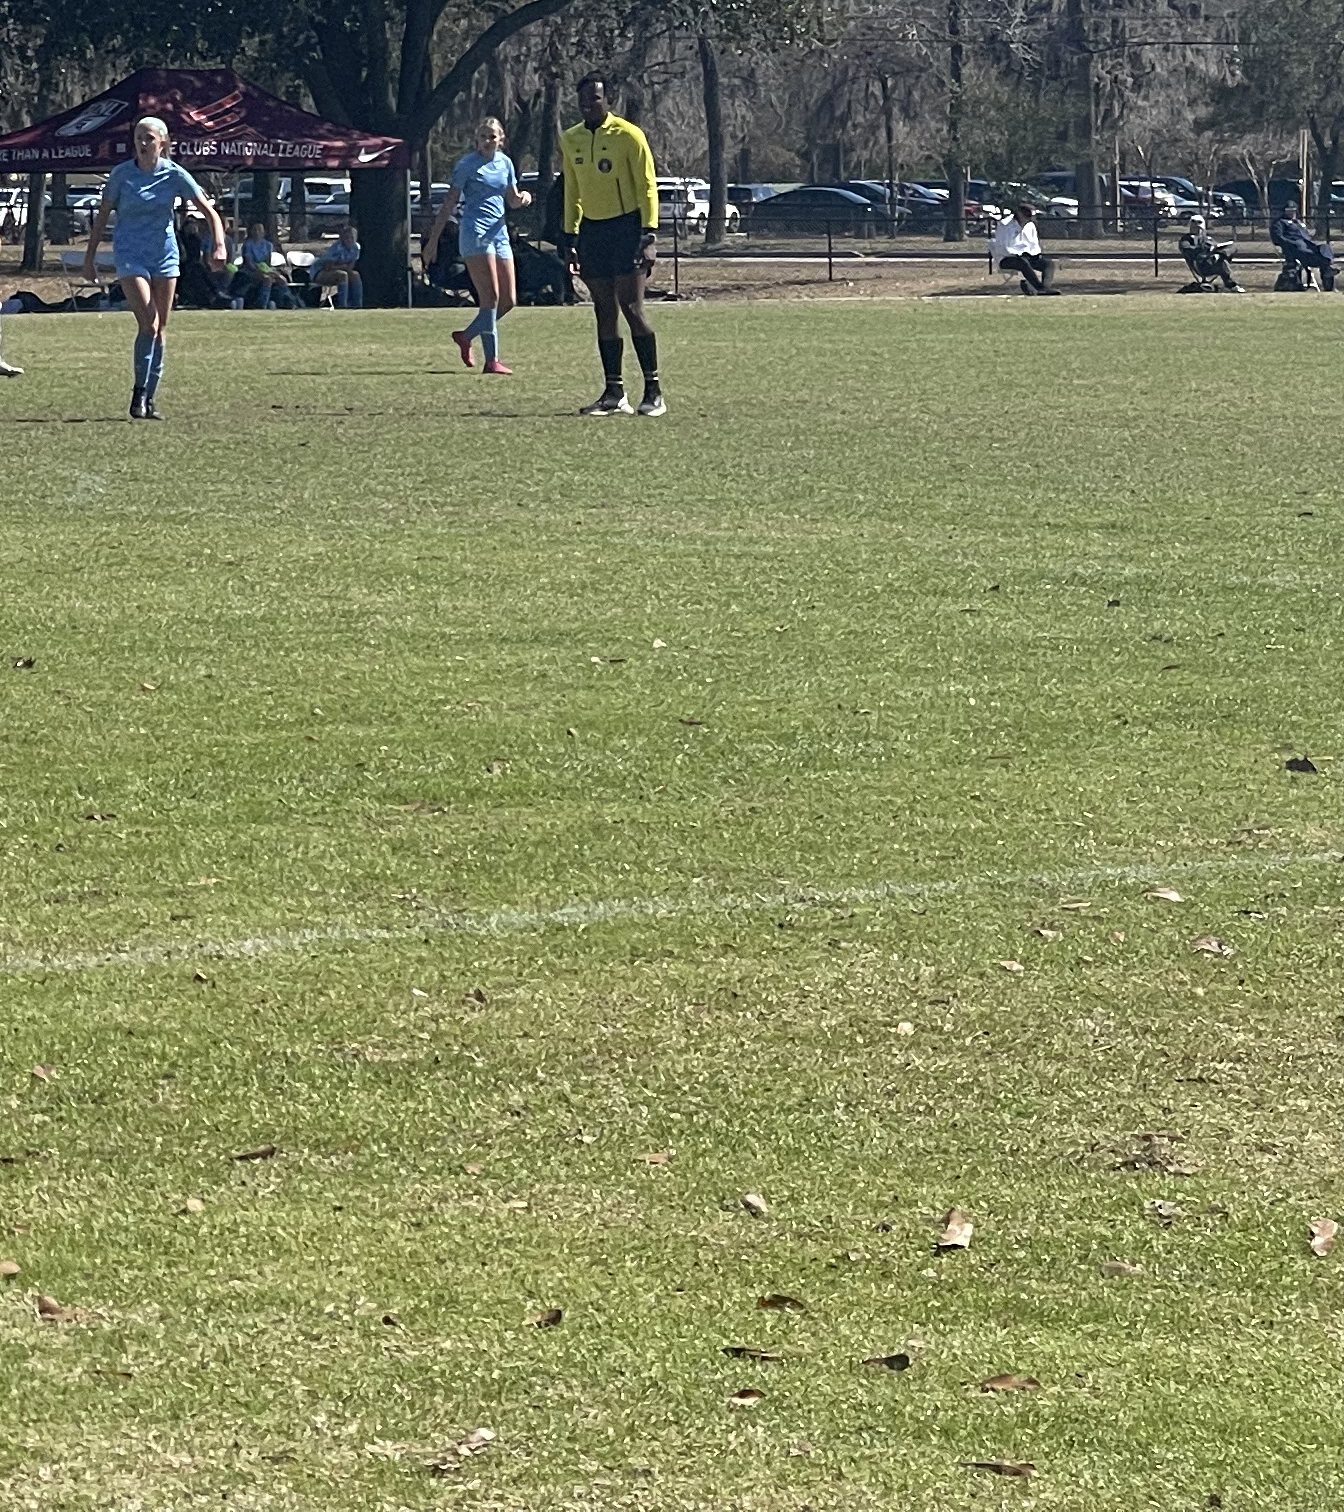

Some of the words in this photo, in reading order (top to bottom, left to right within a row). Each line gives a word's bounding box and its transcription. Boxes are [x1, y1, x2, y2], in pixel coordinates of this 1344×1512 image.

[11, 146, 40, 161] THAN
[41, 147, 50, 160] A
[52, 144, 92, 159] LEAGUE
[179, 141, 218, 156] CLUBS
[221, 141, 276, 157] NATIONAL
[278, 142, 324, 159] LEAGUE
